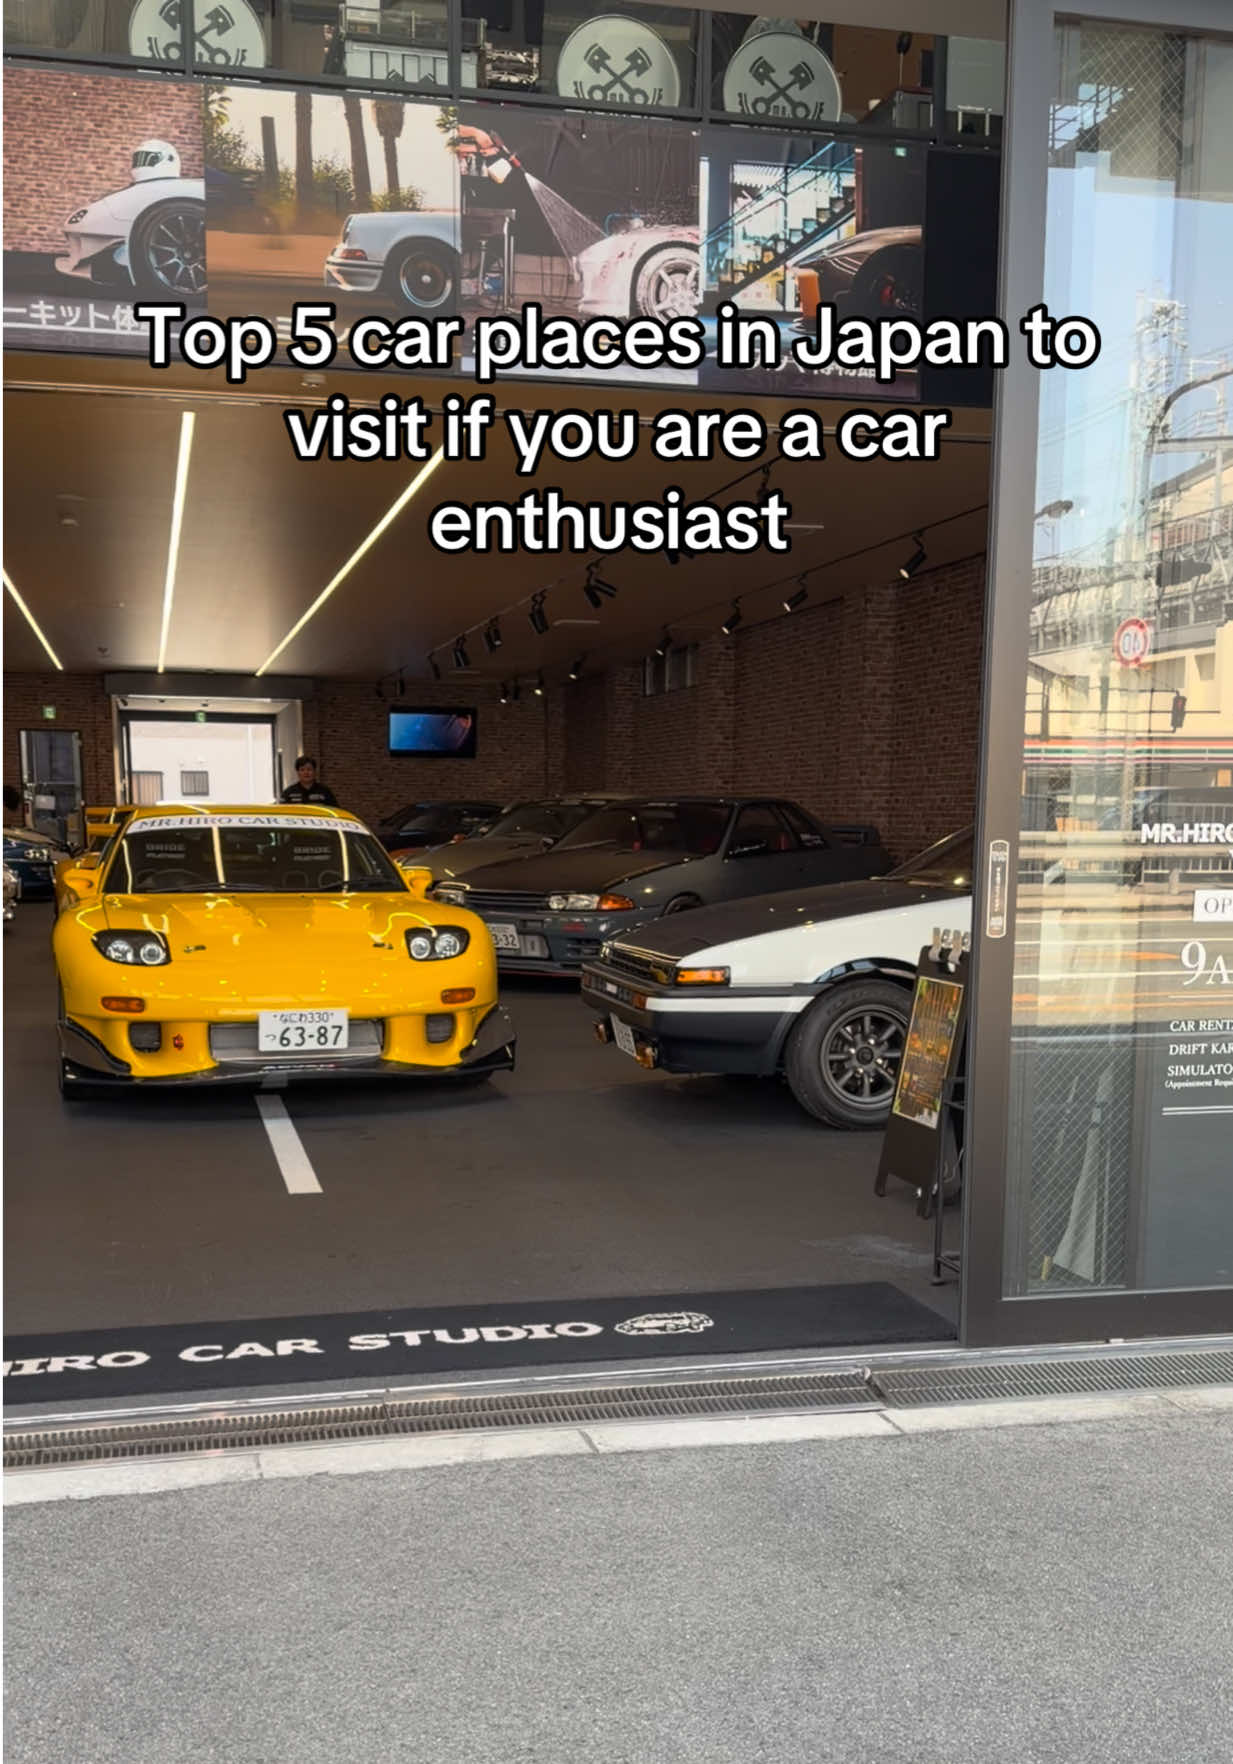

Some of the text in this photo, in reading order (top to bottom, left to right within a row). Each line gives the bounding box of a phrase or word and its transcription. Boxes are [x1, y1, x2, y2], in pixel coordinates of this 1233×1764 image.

[3, 299, 149, 332] ーキット体
[139, 816, 361, 831] MR.HIRO CAR STUDIO
[1181, 940, 1233, 985] 9A
[1169, 1019, 1233, 1032] CAR RENT
[279, 1025, 344, 1047] 63-87
[1169, 1043, 1208, 1055] DRIFT
[1167, 1063, 1233, 1077] SIMULATO
[3, 1321, 603, 1377] IRO CAR STUDIO
